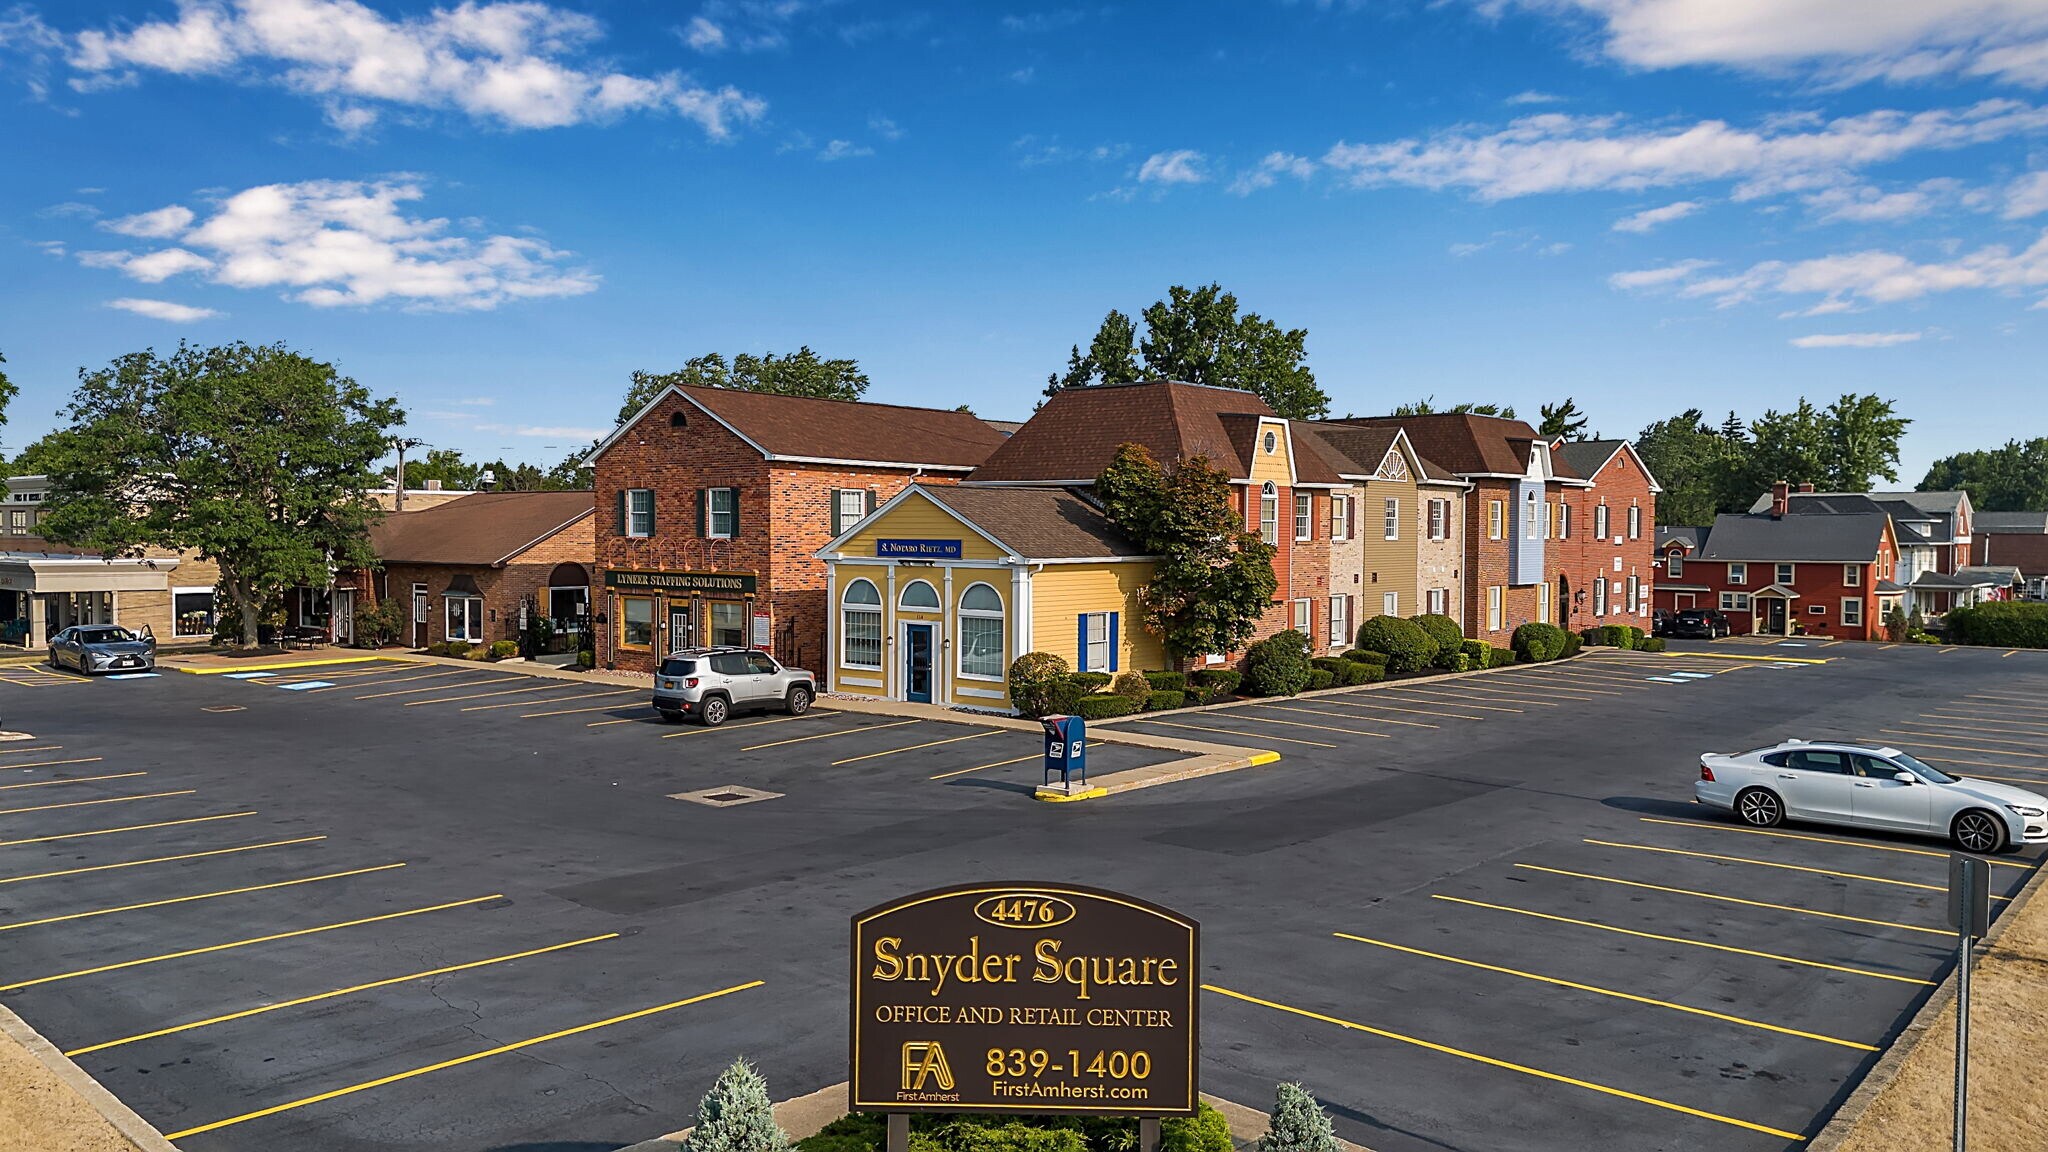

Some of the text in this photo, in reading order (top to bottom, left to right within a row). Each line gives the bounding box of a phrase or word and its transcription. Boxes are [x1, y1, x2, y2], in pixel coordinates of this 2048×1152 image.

[945, 545, 956, 553] MD
[617, 573, 742, 589] LYNEER STAFFING SOLUTIONS
[991, 900, 1055, 922] 4476
[872, 936, 1178, 1000] Snyder Square
[875, 1006, 1174, 1028] OFFICE AND RETAIL CENTER
[901, 1040, 956, 1091] FA
[986, 1047, 1152, 1079] 839-1400
[992, 1080, 1149, 1099] FirstAmherst.com
